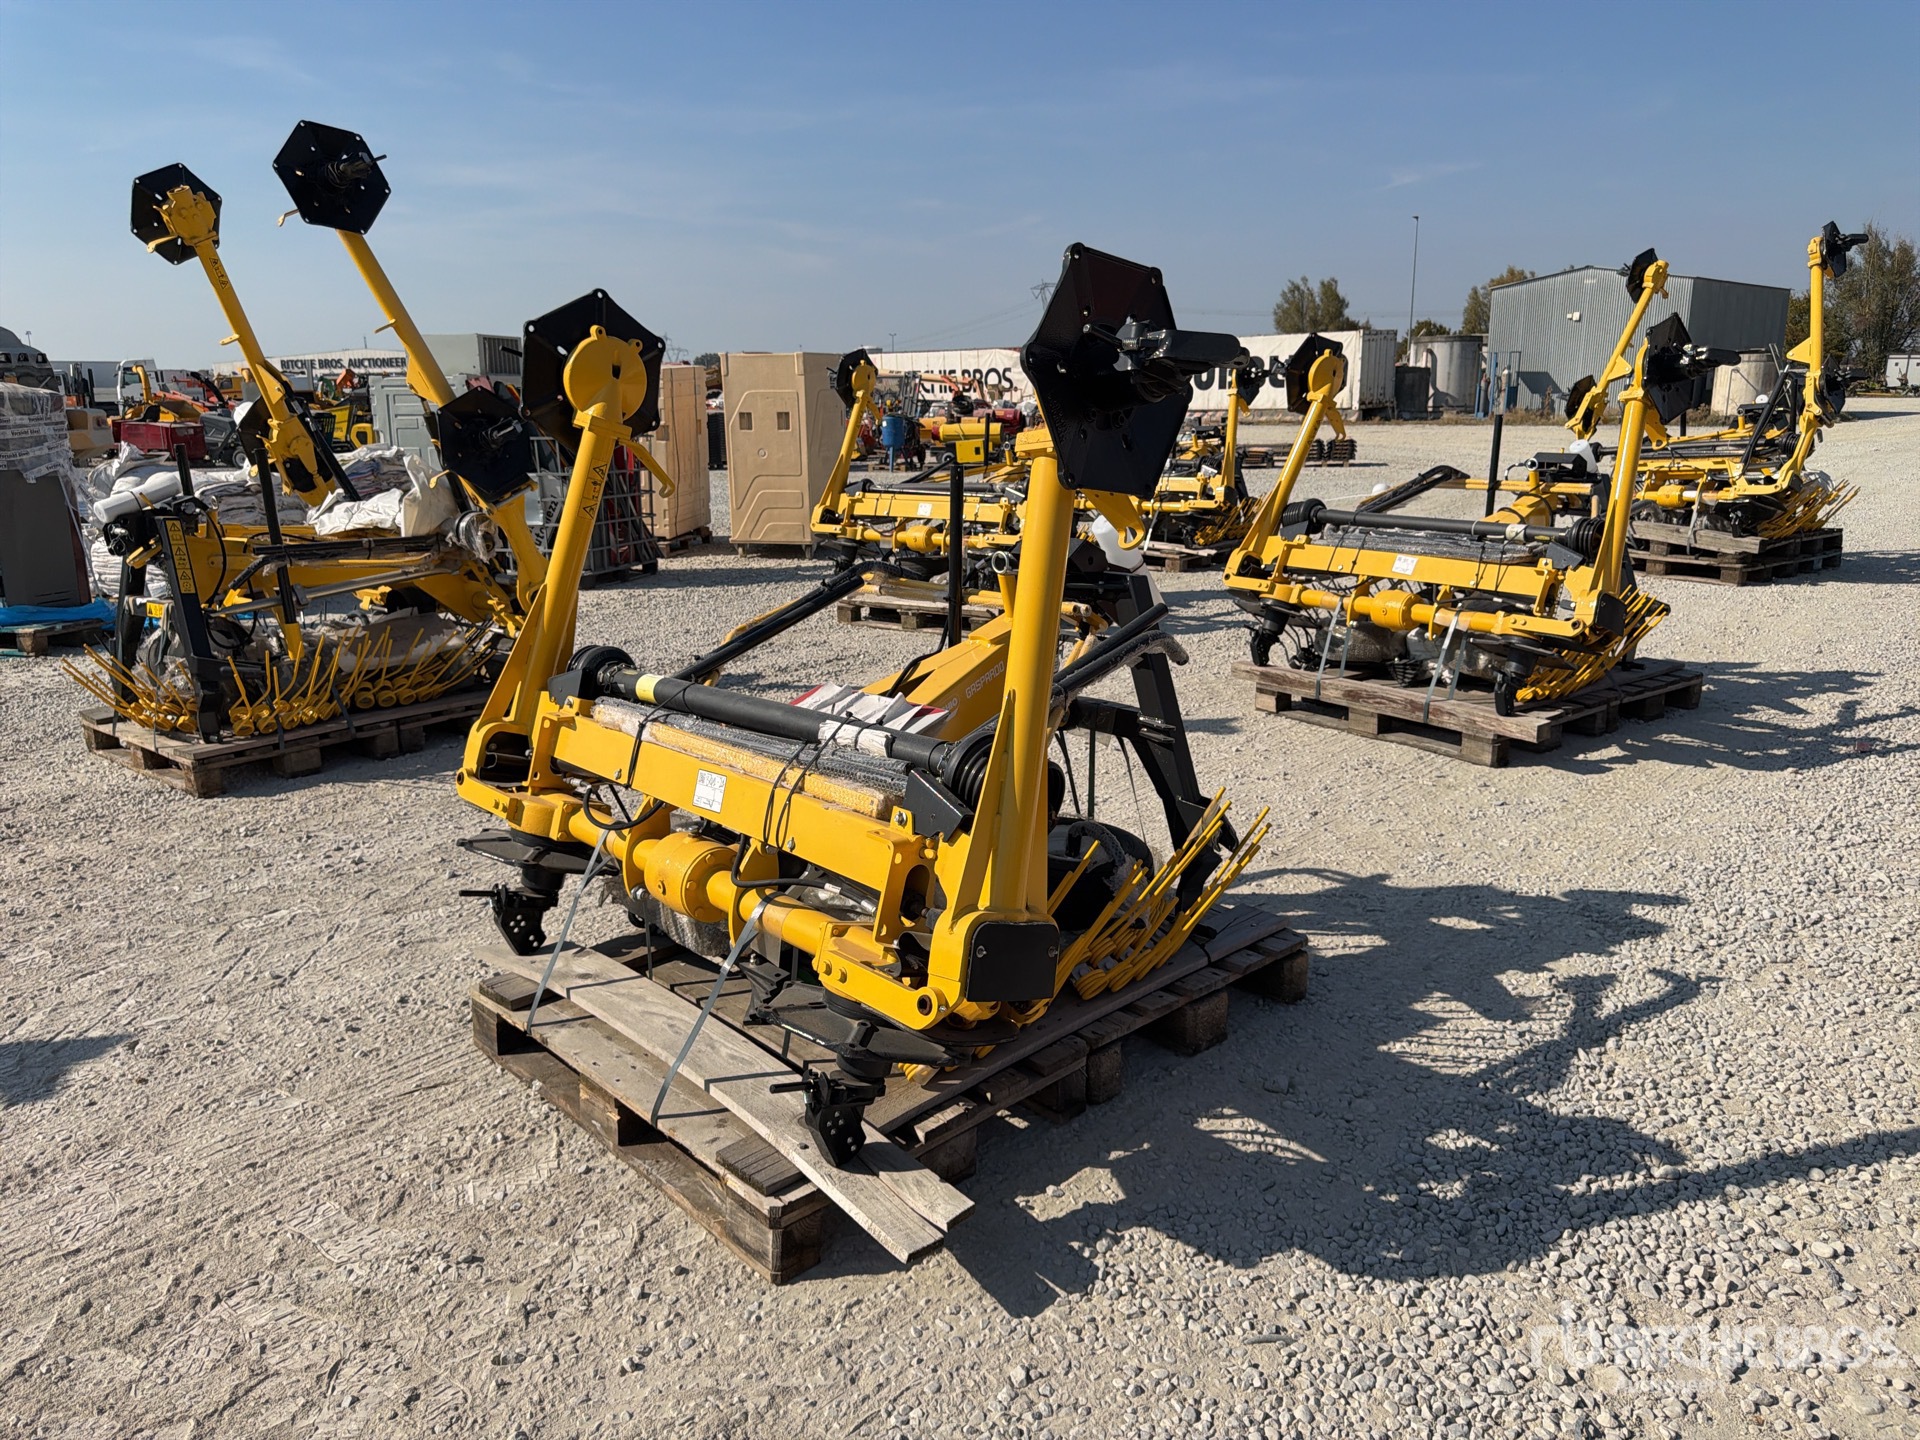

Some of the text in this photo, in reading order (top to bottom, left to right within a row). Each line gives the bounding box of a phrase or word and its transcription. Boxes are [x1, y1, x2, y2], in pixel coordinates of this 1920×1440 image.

[318, 358, 346, 369] BROS.
[348, 357, 407, 369] AUCTIONEER
[965, 660, 1005, 699] GASPARDO
